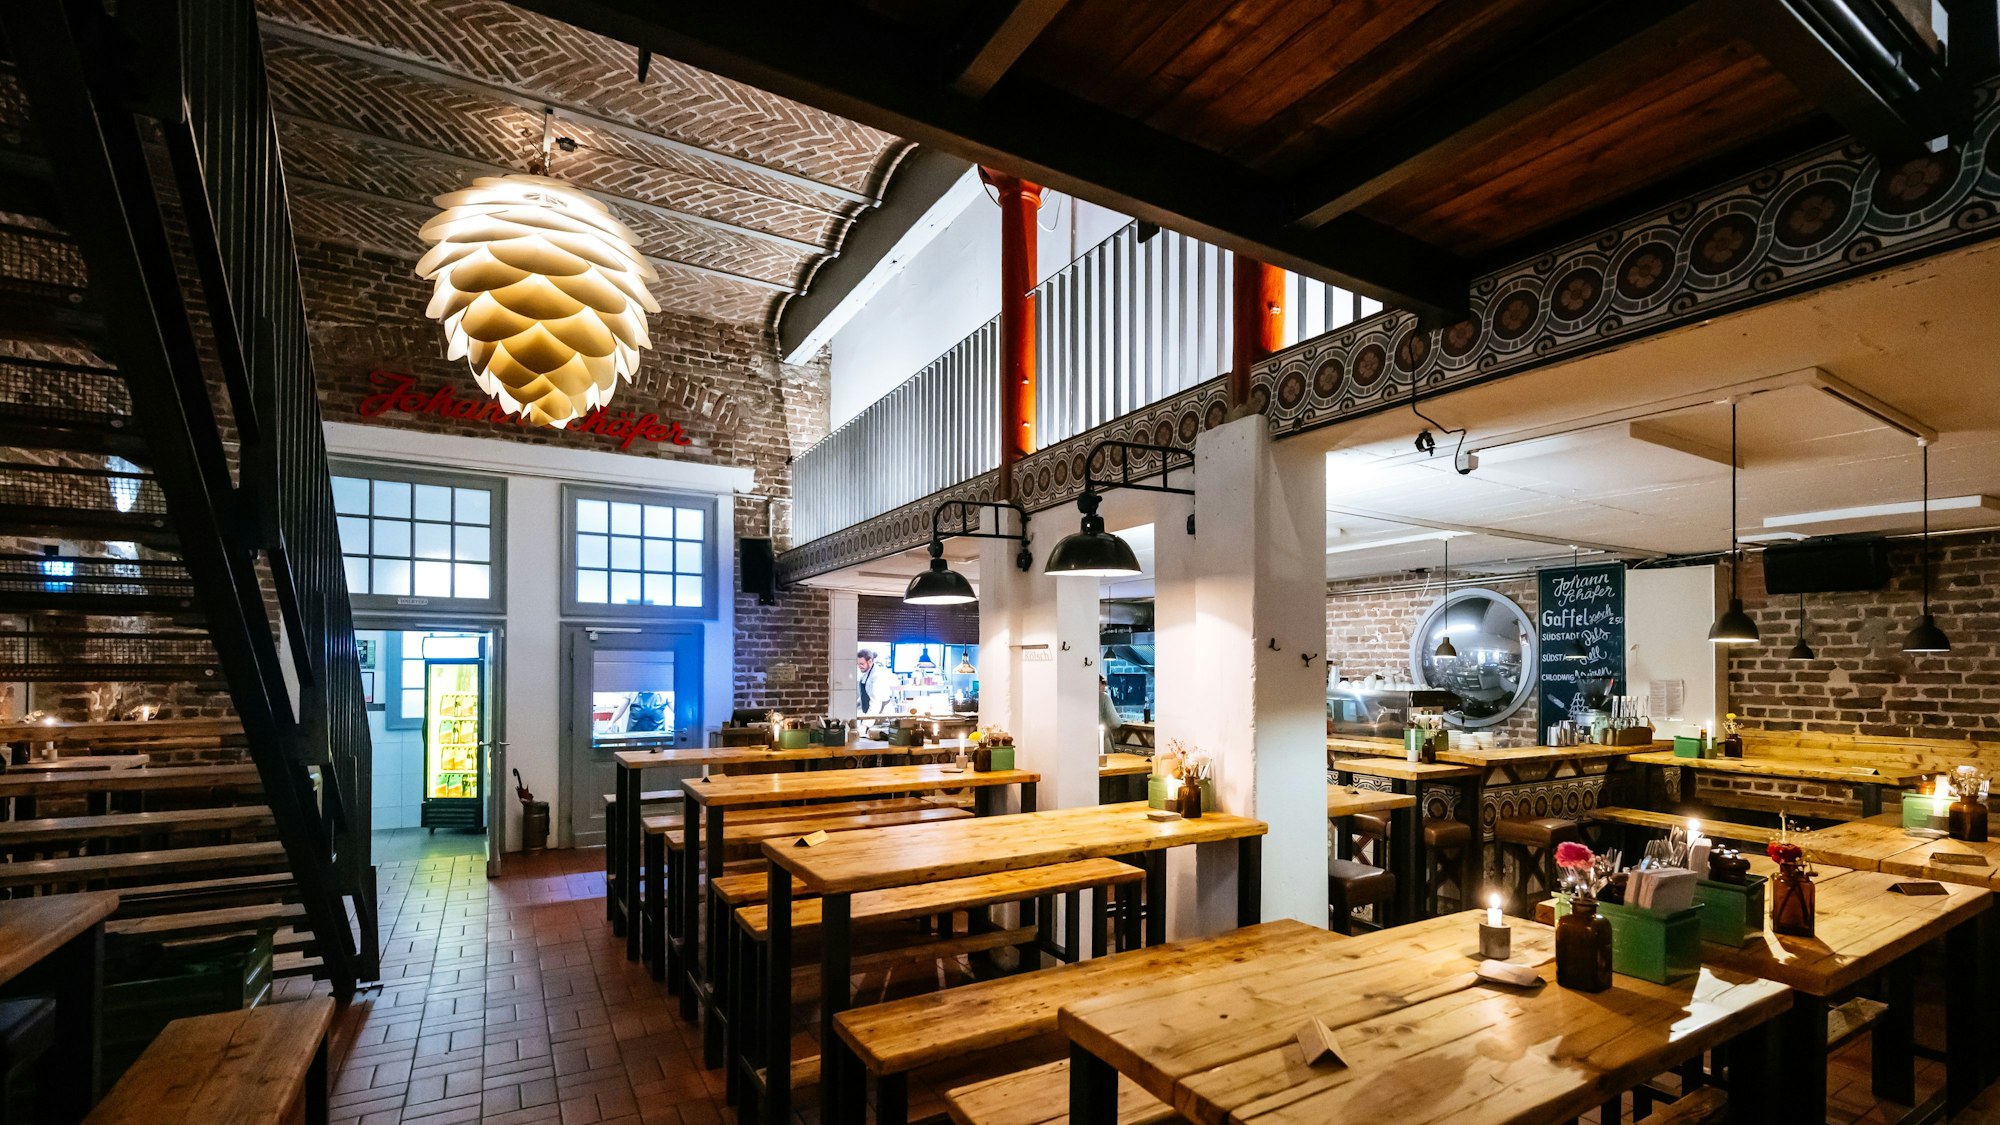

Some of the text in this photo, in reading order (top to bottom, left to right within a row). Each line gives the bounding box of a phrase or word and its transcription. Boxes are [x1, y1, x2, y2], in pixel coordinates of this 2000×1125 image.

[543, 404, 692, 449] chäfer
[1552, 573, 1609, 597] Johann
[1558, 585, 1616, 607] Schäfer
[1542, 608, 1590, 628] Gaffel
[1542, 631, 1580, 641] SÜDSTADT
[1541, 673, 1575, 681] CHLODWIG
